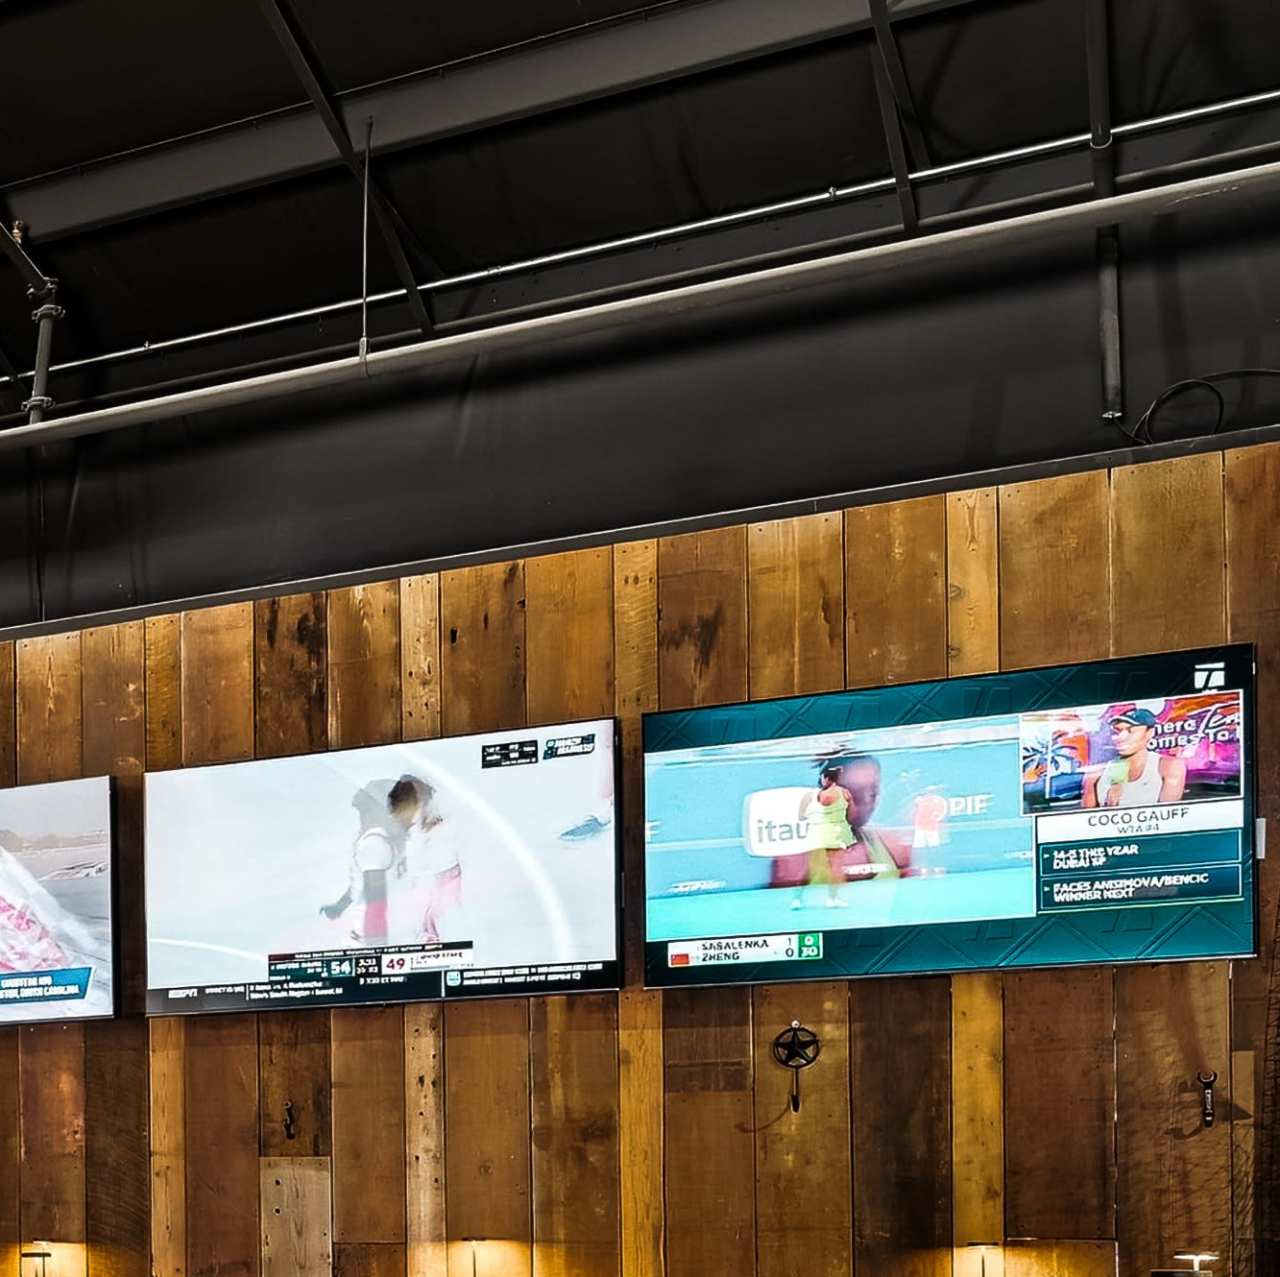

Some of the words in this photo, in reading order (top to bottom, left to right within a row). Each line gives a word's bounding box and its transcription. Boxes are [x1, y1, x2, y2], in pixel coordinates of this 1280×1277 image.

[1088, 812, 1132, 827] COCO
[1137, 807, 1190, 823] GAUFF
[386, 958, 406, 971] 49
